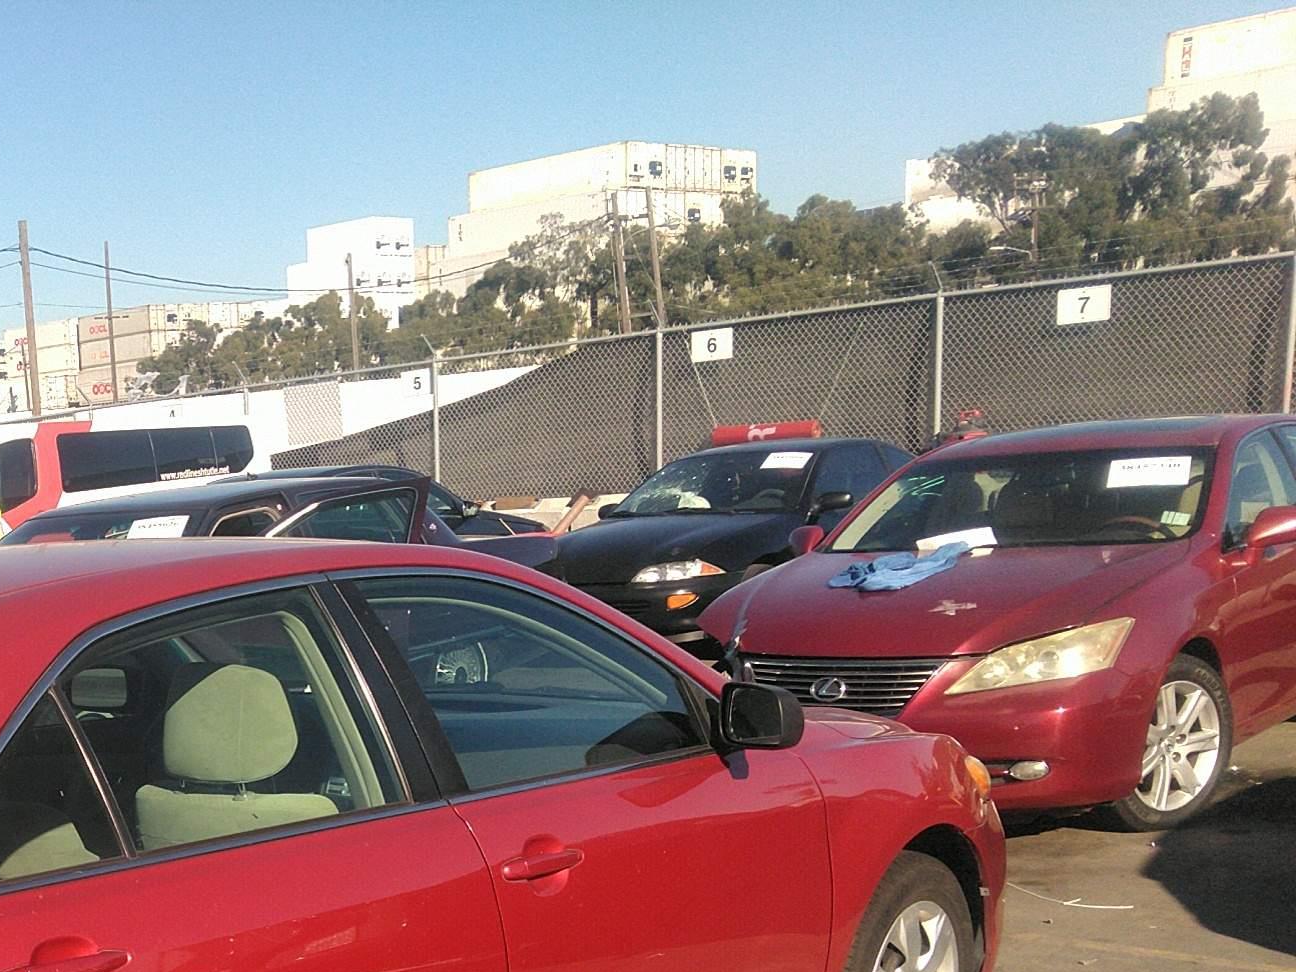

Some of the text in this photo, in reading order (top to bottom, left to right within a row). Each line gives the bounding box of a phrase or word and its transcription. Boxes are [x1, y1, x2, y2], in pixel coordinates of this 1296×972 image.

[1077, 296, 1091, 314] 7
[14, 337, 29, 347] OOC
[707, 337, 717, 353] 6
[92, 382, 113, 395] OOC
[413, 376, 422, 390] 5
